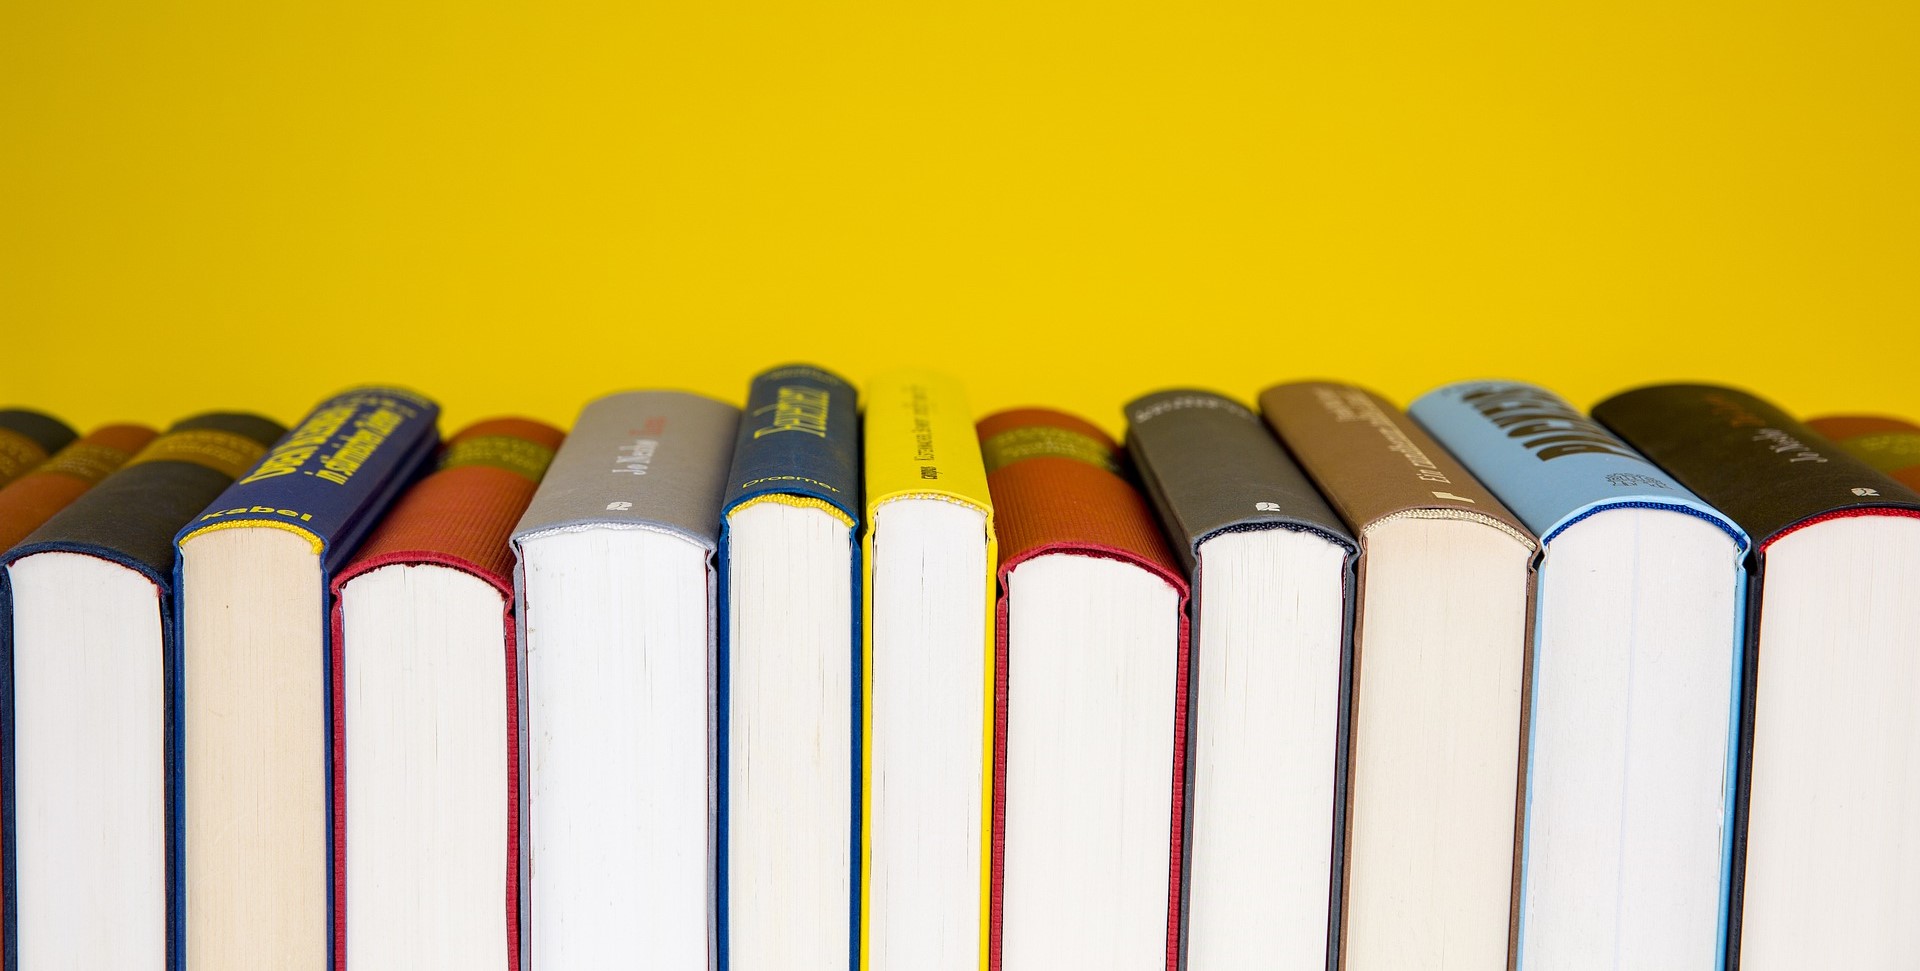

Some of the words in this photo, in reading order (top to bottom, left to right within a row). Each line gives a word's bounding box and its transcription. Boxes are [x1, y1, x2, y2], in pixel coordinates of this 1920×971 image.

[304, 469, 349, 486] in
[612, 464, 648, 476] Jo
[742, 474, 841, 493] Droemer
[199, 505, 313, 522] Kabel
